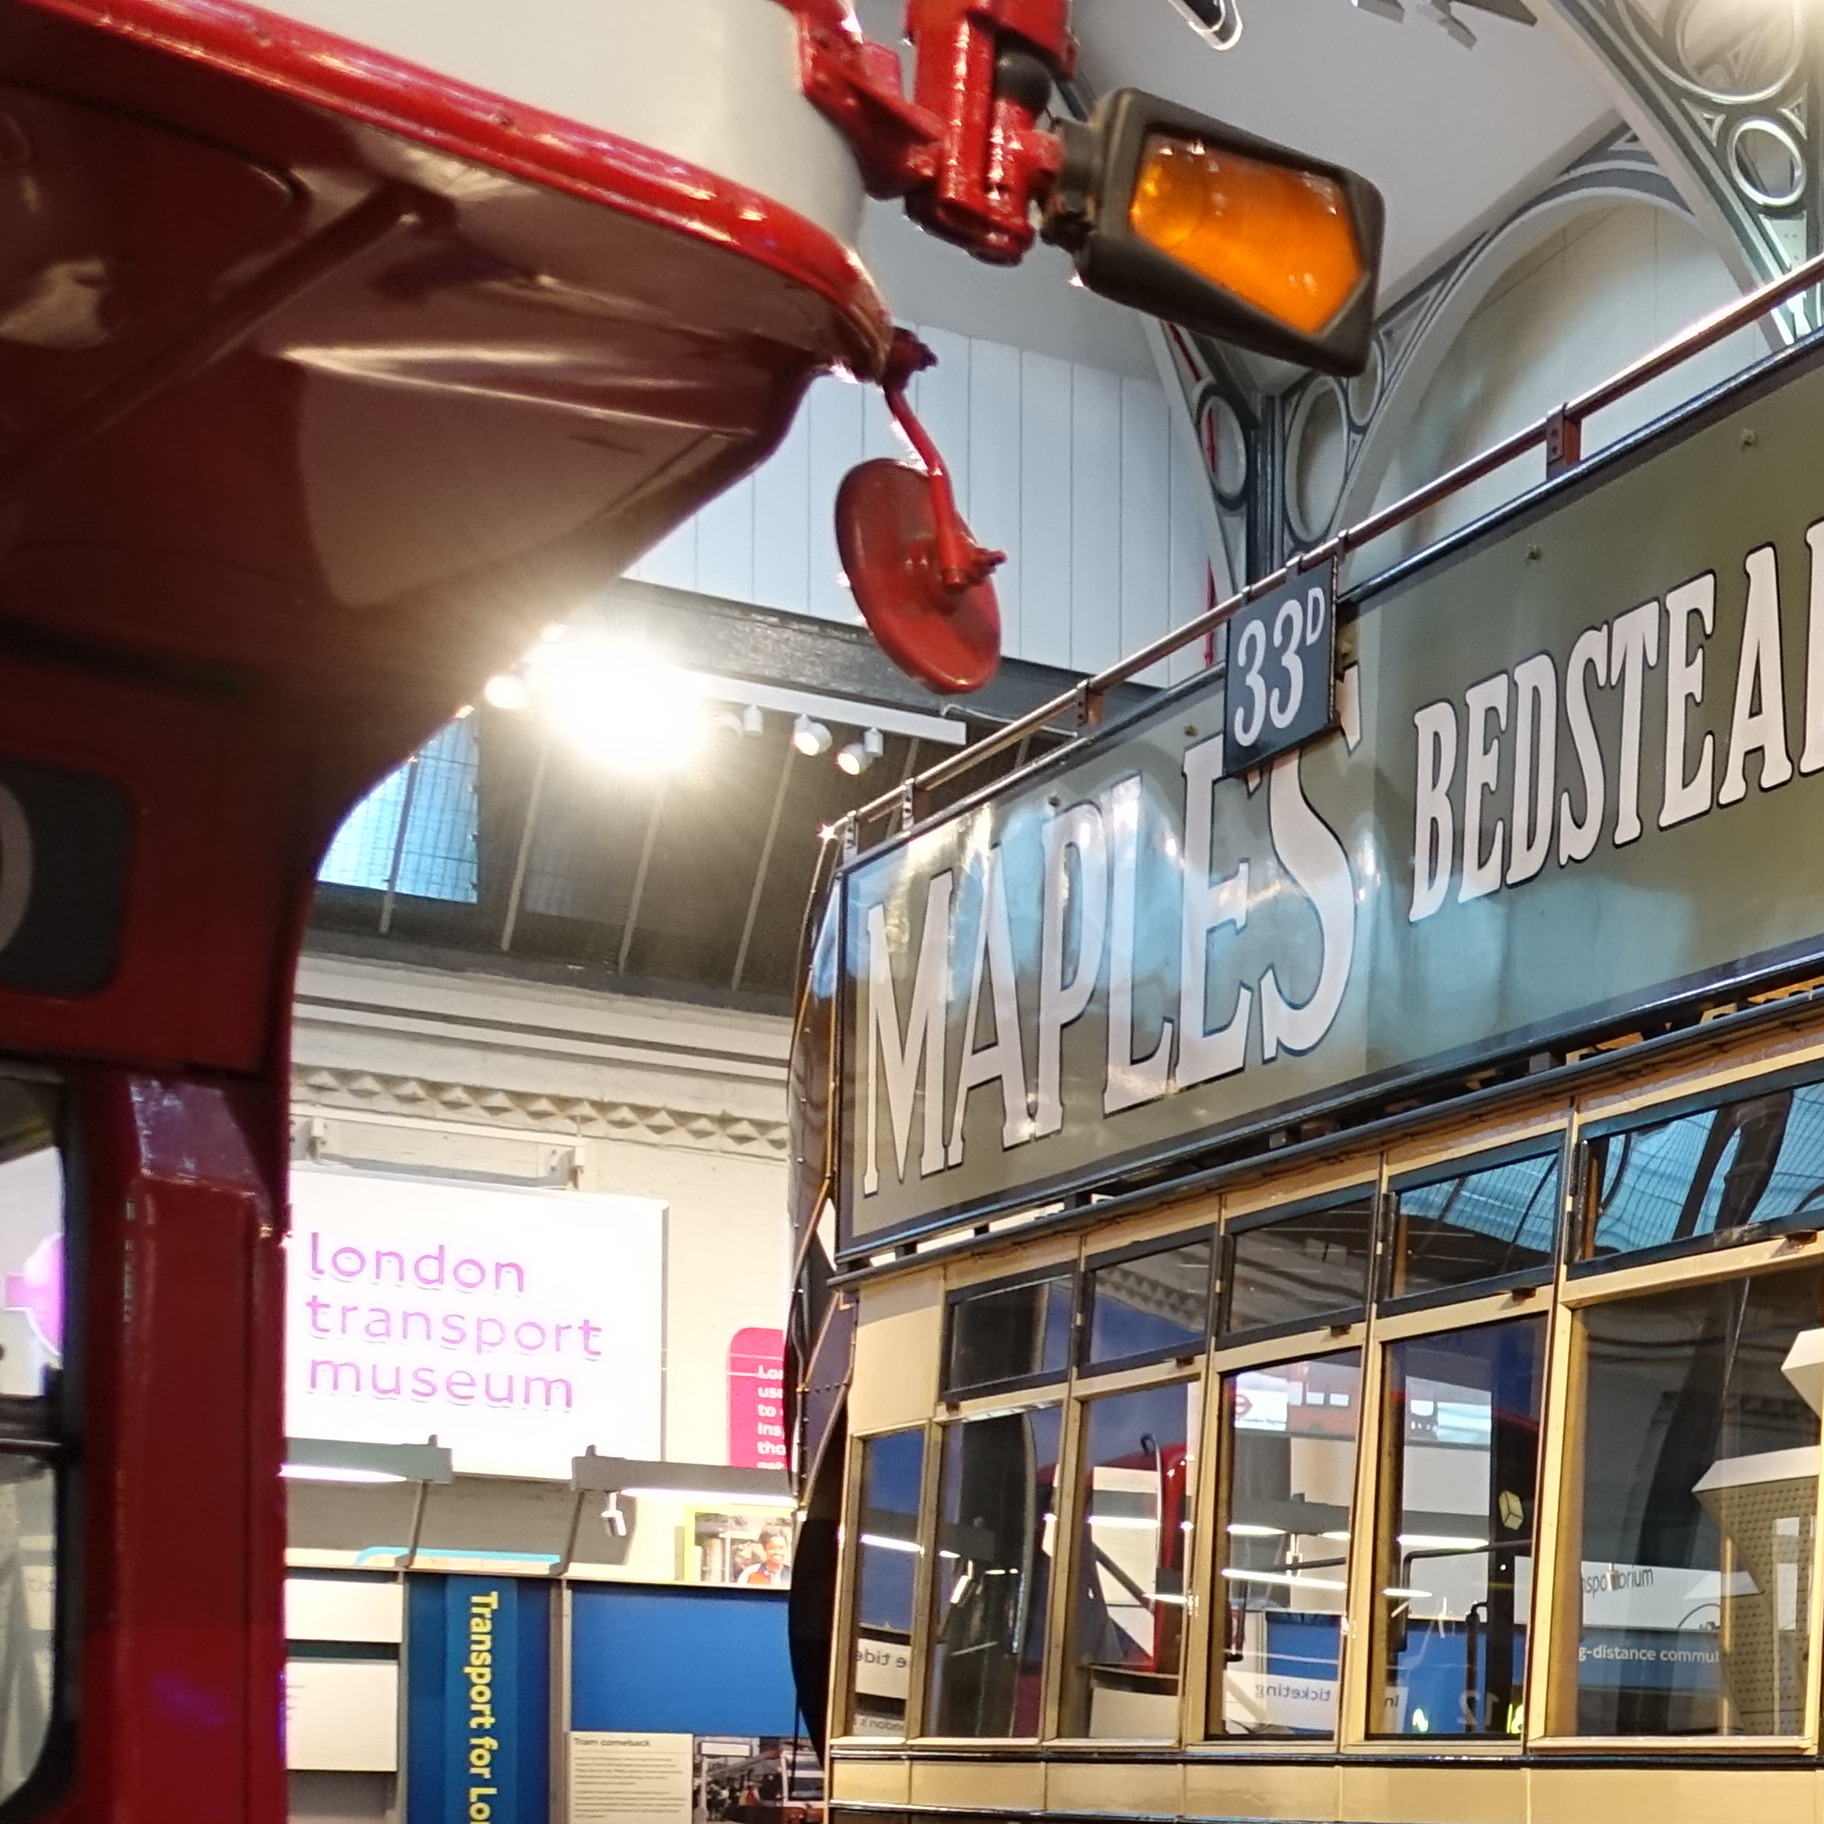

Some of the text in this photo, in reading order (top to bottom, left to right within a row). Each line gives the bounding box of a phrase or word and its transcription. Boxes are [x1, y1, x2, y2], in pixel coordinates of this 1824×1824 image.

[863, 664, 1363, 1196] MAPLES
[309, 1232, 526, 1294] london
[306, 1293, 604, 1357] transport
[308, 1353, 574, 1409] museum
[462, 1590, 499, 1725] Transport
[470, 1730, 499, 1779] for
[574, 1737, 651, 1748] Tram comeback
